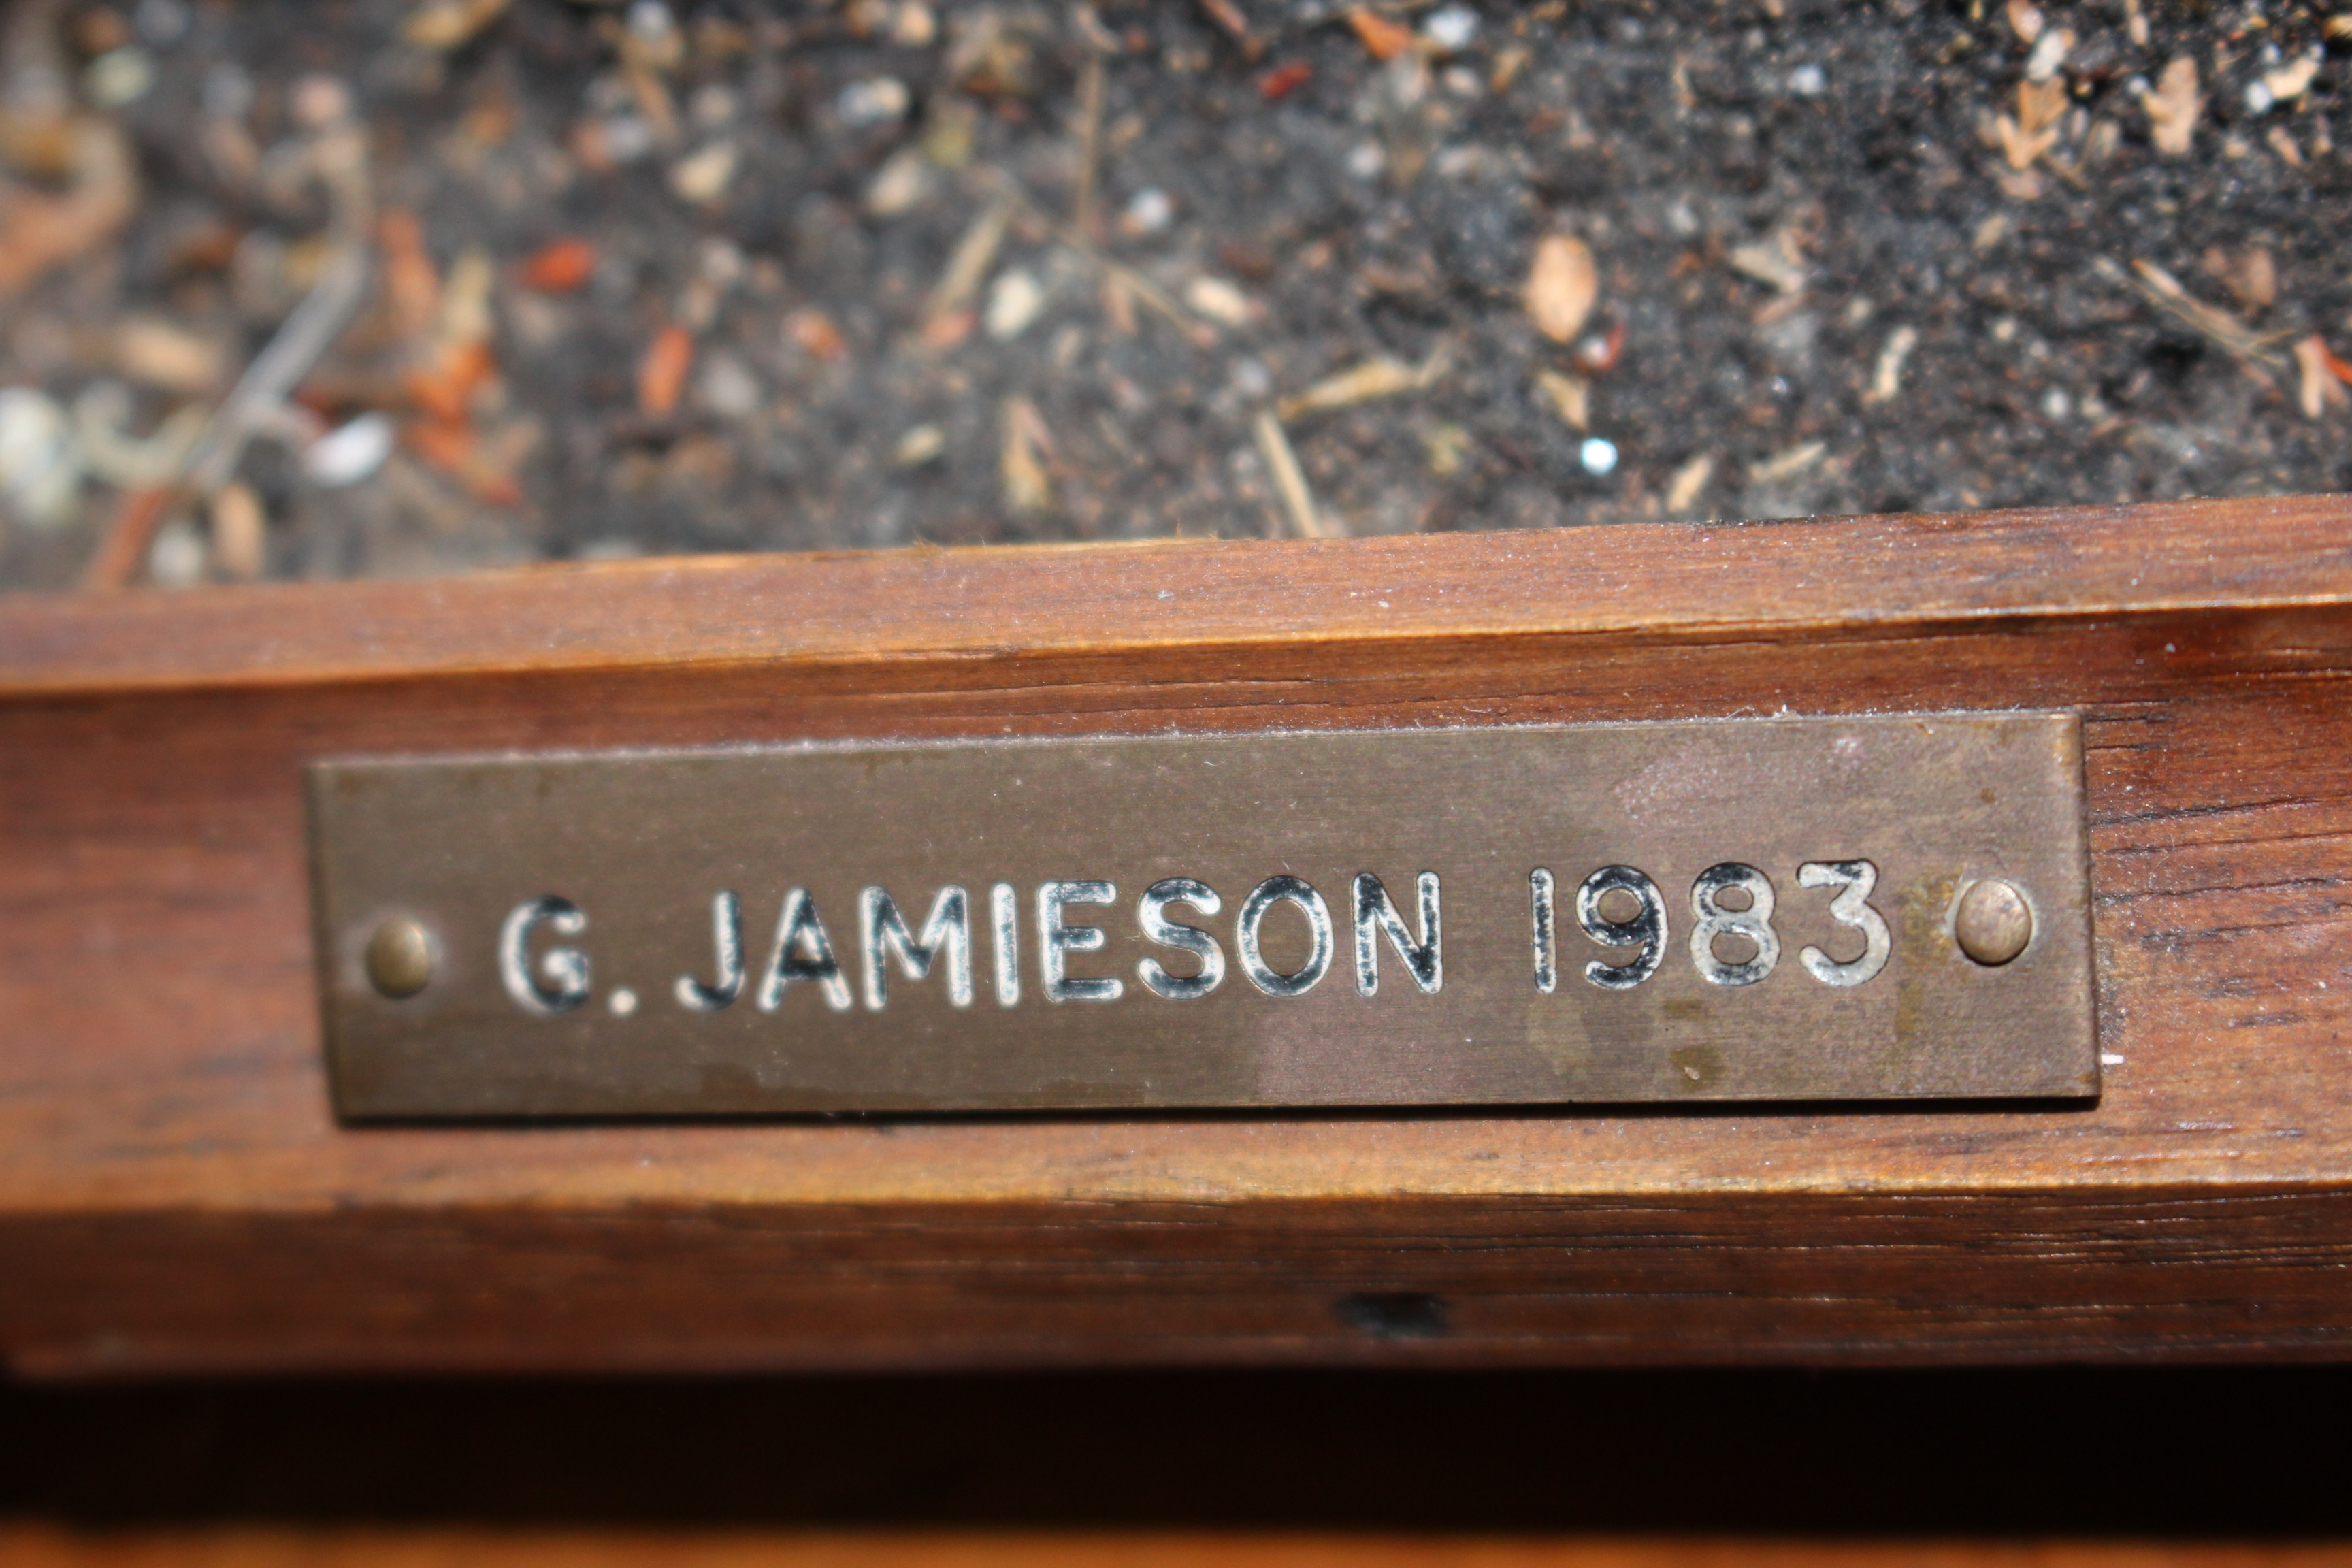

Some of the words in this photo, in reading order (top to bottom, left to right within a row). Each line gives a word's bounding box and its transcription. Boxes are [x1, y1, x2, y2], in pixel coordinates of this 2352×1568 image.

[500, 896, 638, 1016] G.
[675, 870, 1443, 1011] JAMIESON
[1530, 859, 1891, 994] 1983
